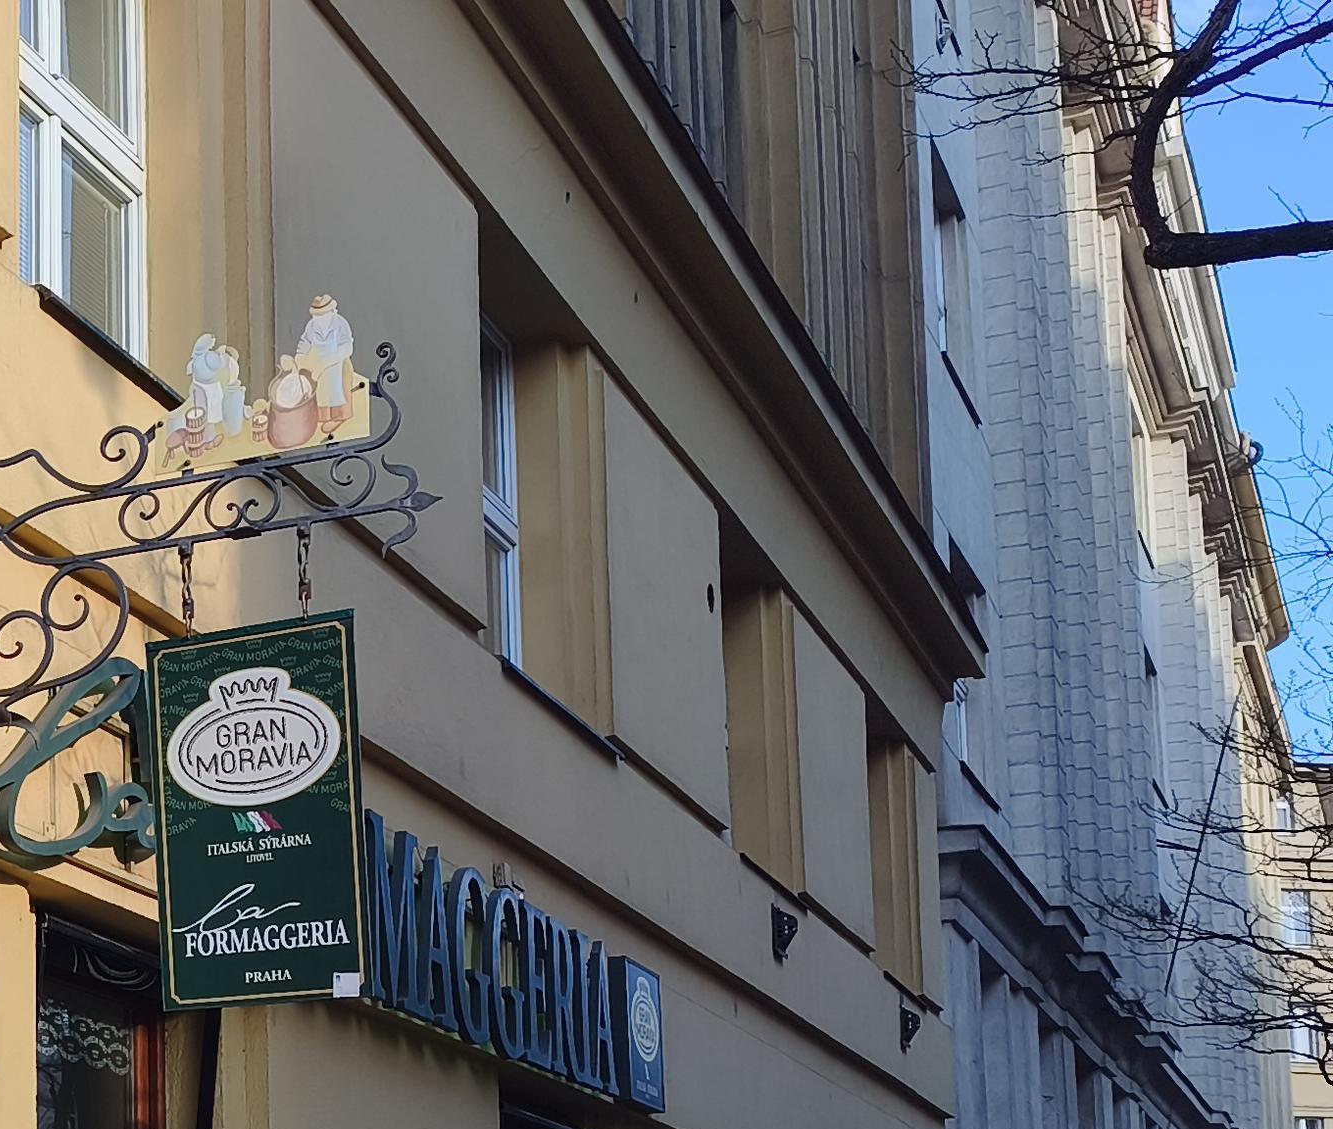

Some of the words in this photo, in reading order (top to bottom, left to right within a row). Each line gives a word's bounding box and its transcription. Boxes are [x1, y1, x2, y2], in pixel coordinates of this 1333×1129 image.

[216, 716, 287, 748] GRAN
[195, 740, 312, 778] MORAVIA
[207, 837, 254, 857] ITALSKÁ
[259, 833, 313, 851] SÝRÁRNA
[246, 851, 274, 864] LITOVEL
[172, 883, 301, 933] La
[184, 918, 350, 958] FORMAGGERIA
[245, 968, 292, 984] PRAHA
